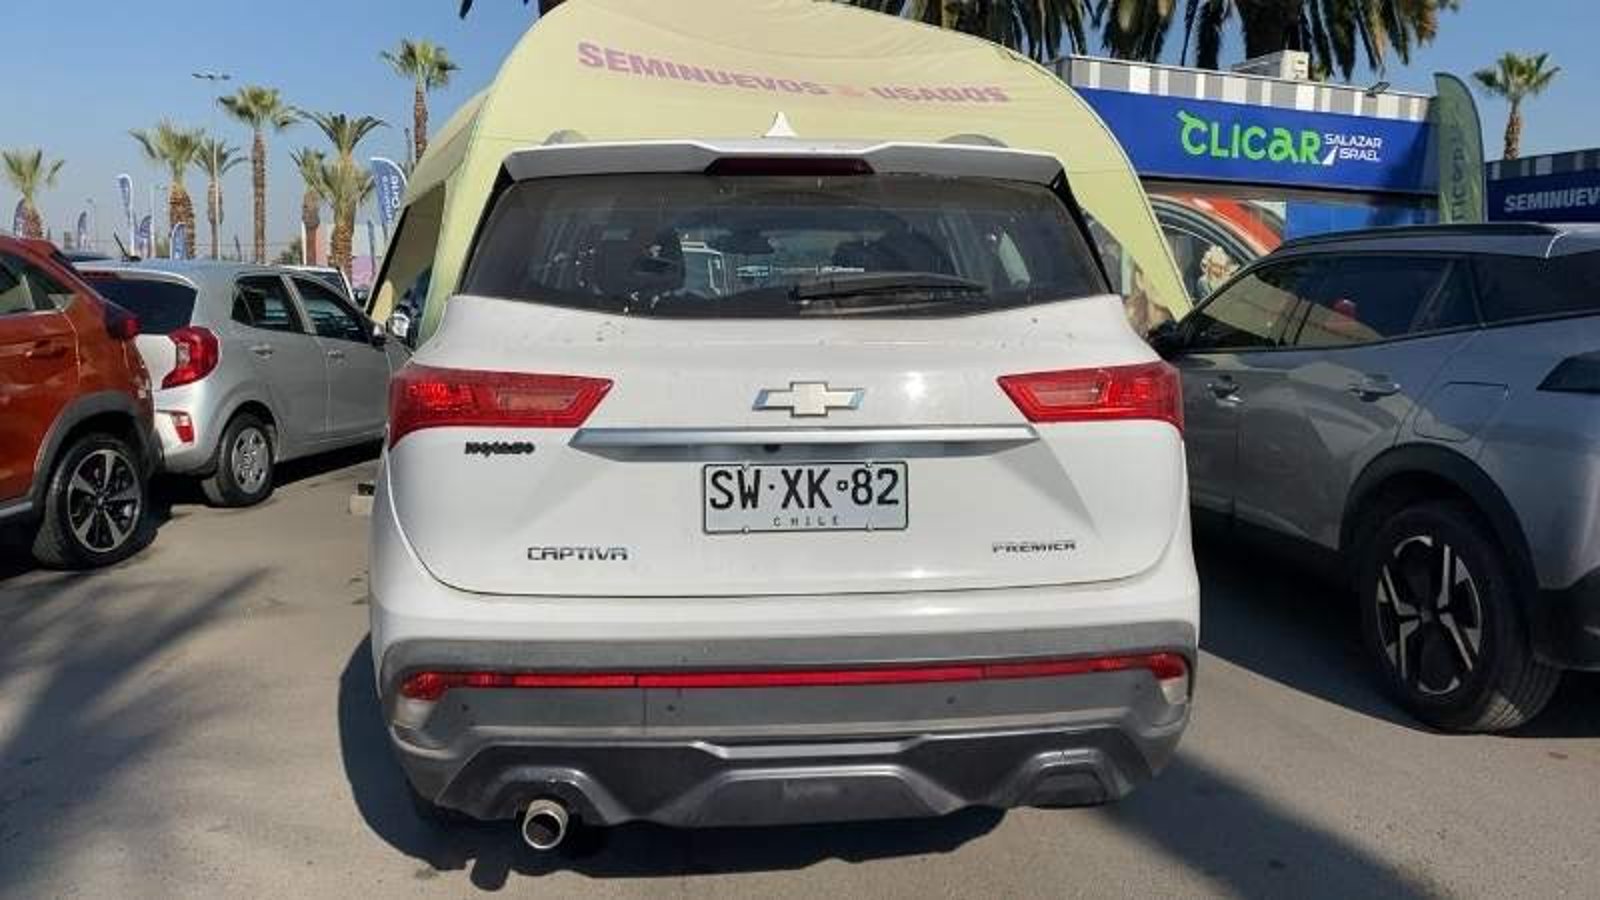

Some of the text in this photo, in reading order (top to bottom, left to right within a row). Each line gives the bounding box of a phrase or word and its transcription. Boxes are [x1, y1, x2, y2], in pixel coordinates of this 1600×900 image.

[577, 41, 828, 96] SEMINUEVOS
[870, 85, 1010, 104] USADOS
[1324, 133, 1382, 148] SALAZAR
[1339, 147, 1380, 162] ISRAEL
[773, 515, 839, 527] CHILE
[527, 547, 629, 561] CAPTIVA
